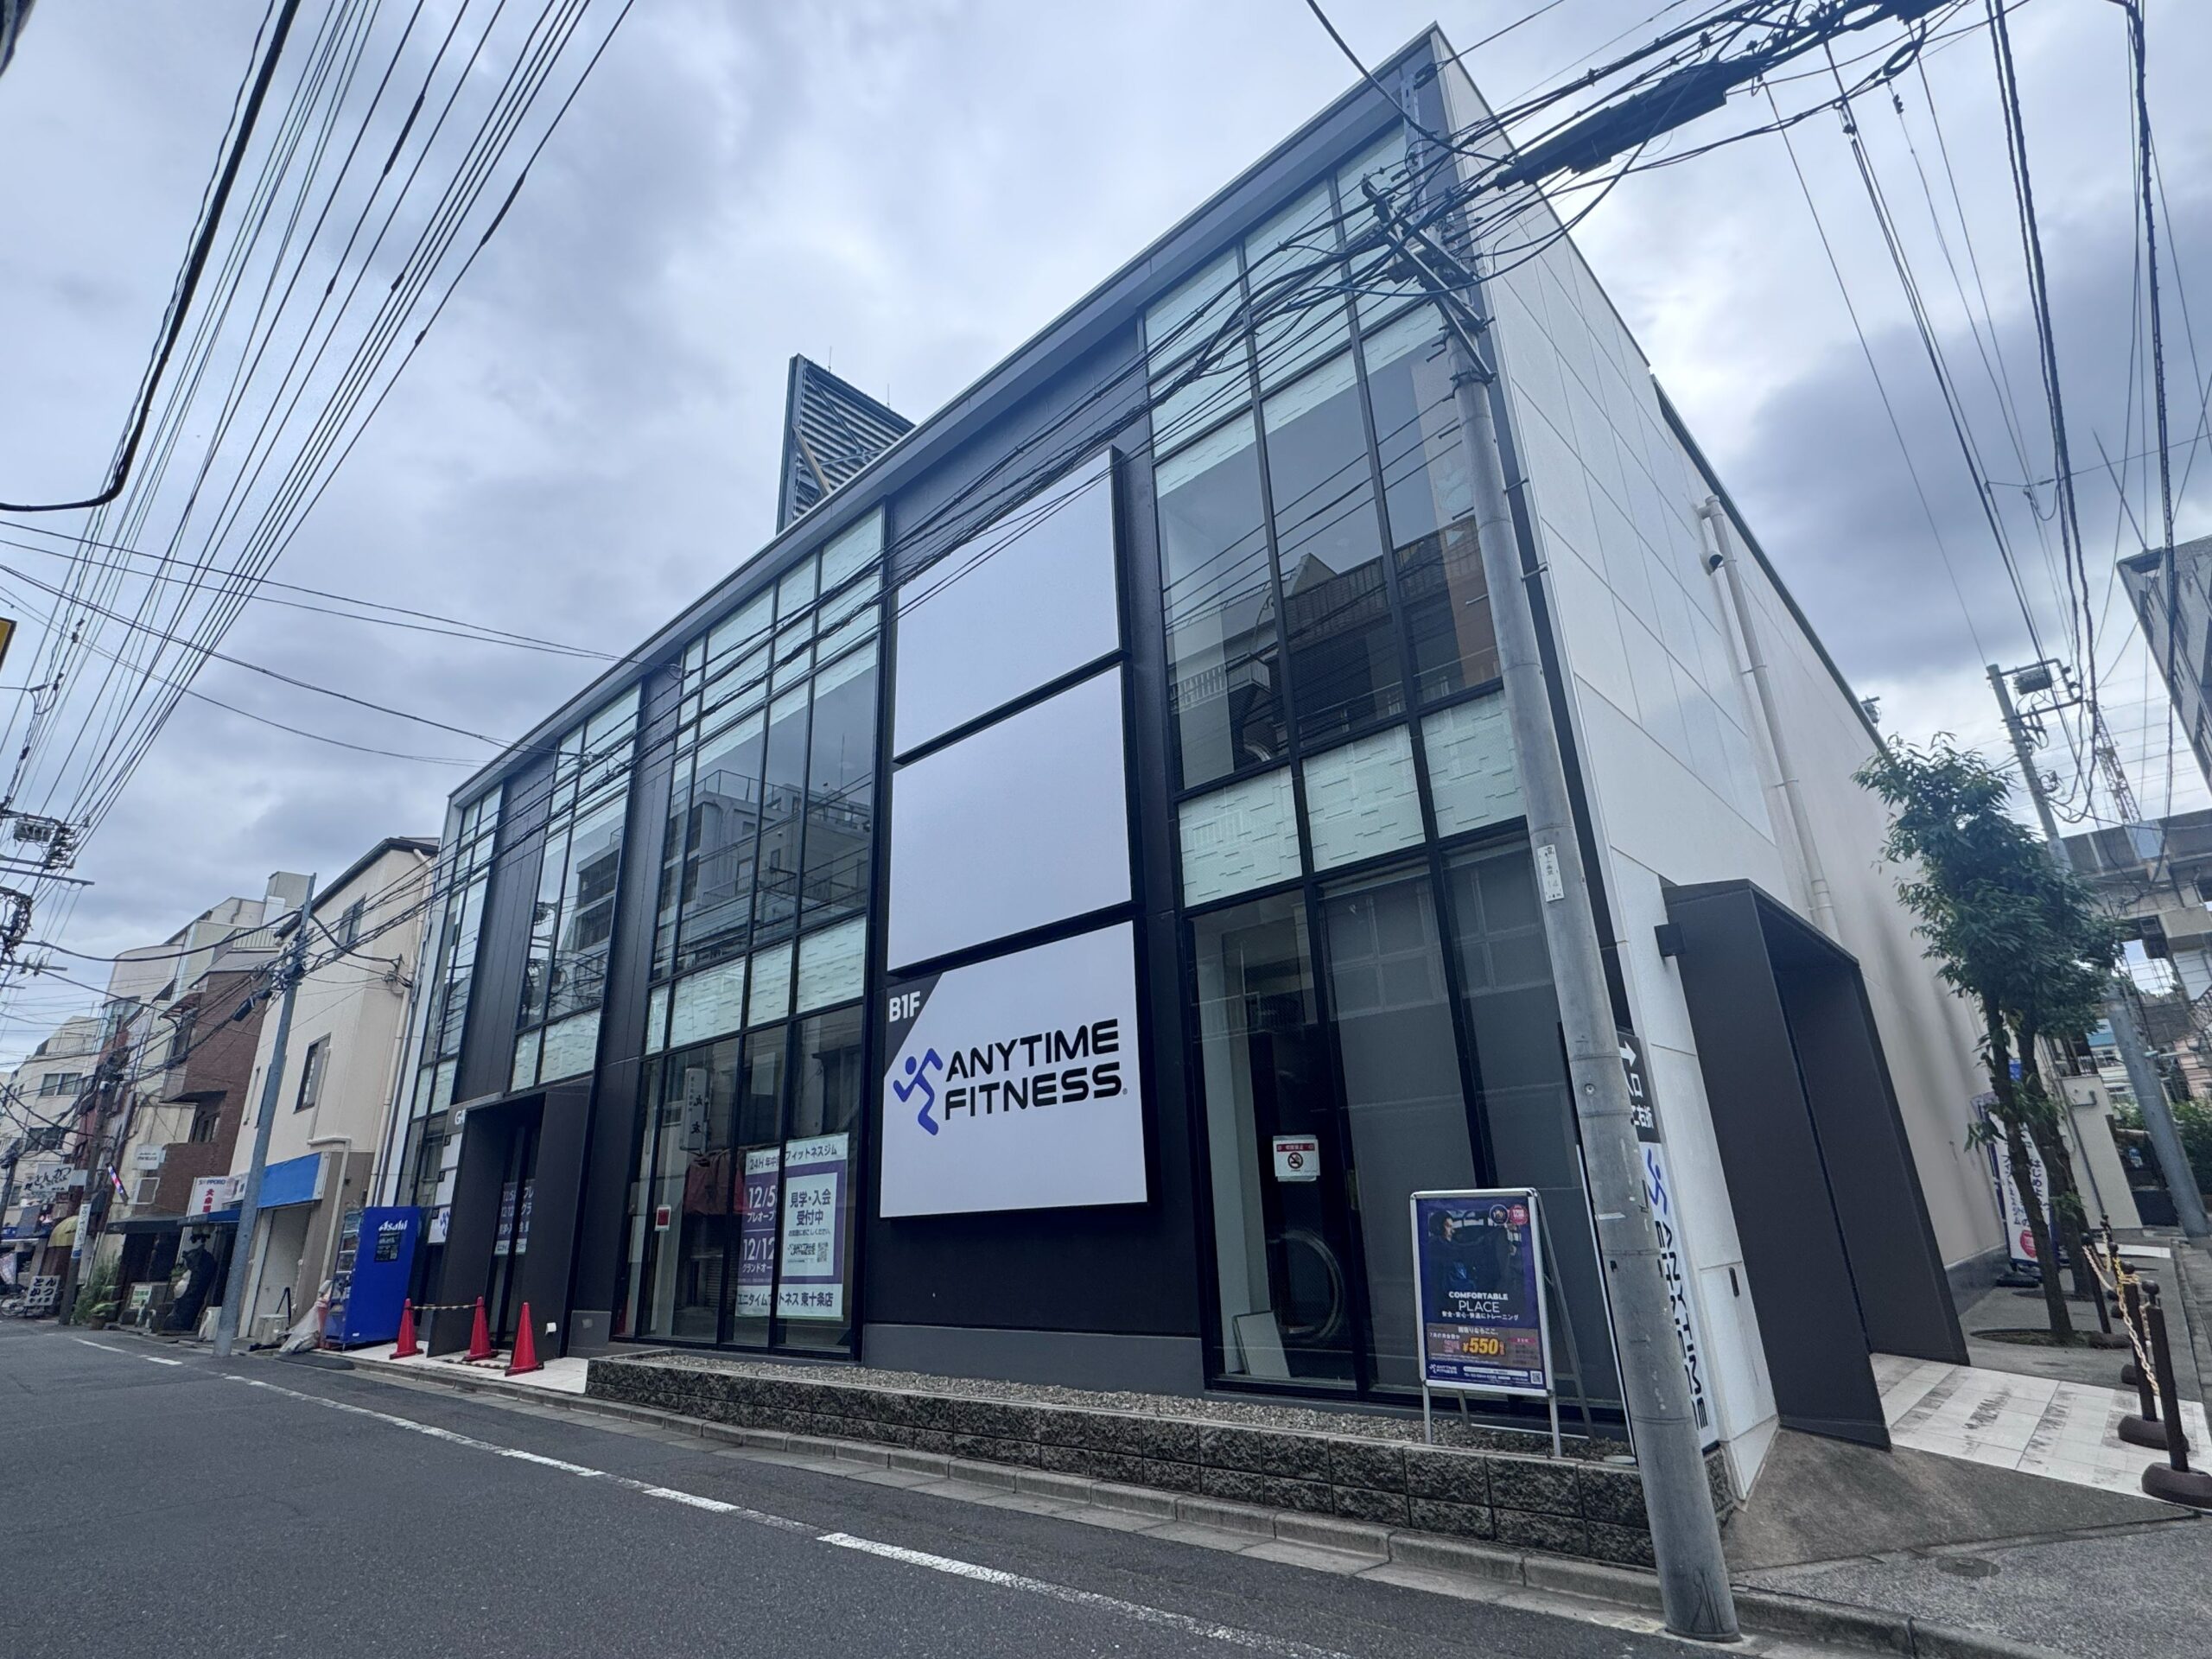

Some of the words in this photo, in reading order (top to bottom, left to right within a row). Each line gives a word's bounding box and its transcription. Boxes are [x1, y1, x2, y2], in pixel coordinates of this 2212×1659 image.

[888, 991, 921, 1023] B1F
[945, 1018, 1120, 1082] ANYTIME
[945, 1061, 1122, 1121] FITNESS
[785, 1144, 837, 1161] フィットネスジム
[748, 1185, 777, 1210] 12/5
[790, 1188, 831, 1208] 見学・入会
[378, 1219, 409, 1231] Asahi
[796, 1210, 824, 1227] 受付中
[800, 1292, 834, 1307] 東十条店
[1448, 1291, 1509, 1300] COMFORTABLE
[1459, 1300, 1500, 1313] PLACE
[1662, 1221, 1708, 1430] ANYTIME
[1462, 1337, 1499, 1355] ¥550
